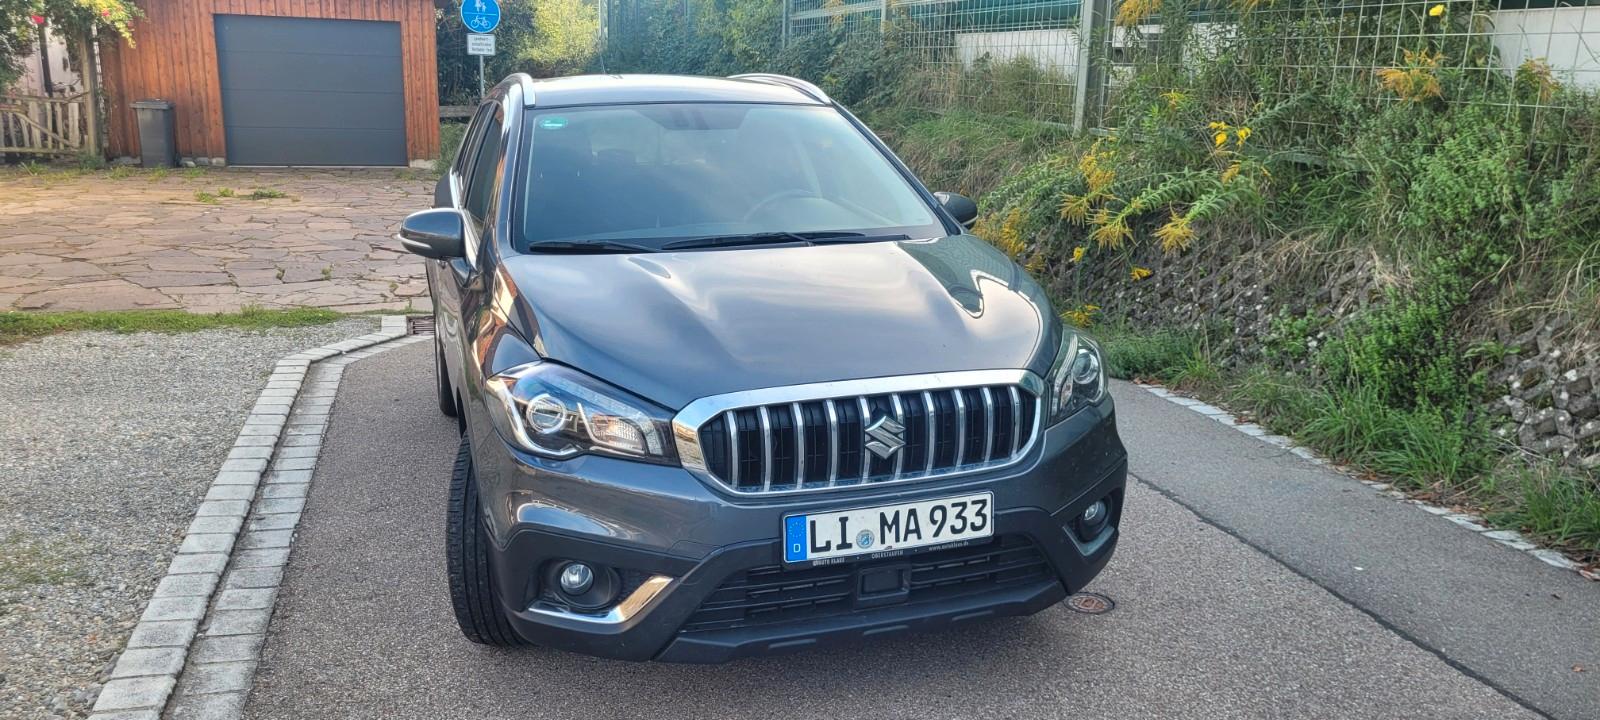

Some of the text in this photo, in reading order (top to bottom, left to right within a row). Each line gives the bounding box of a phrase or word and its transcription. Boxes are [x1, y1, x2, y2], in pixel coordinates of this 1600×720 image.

[810, 498, 988, 553] LI MA 933
[793, 543, 801, 553] D
